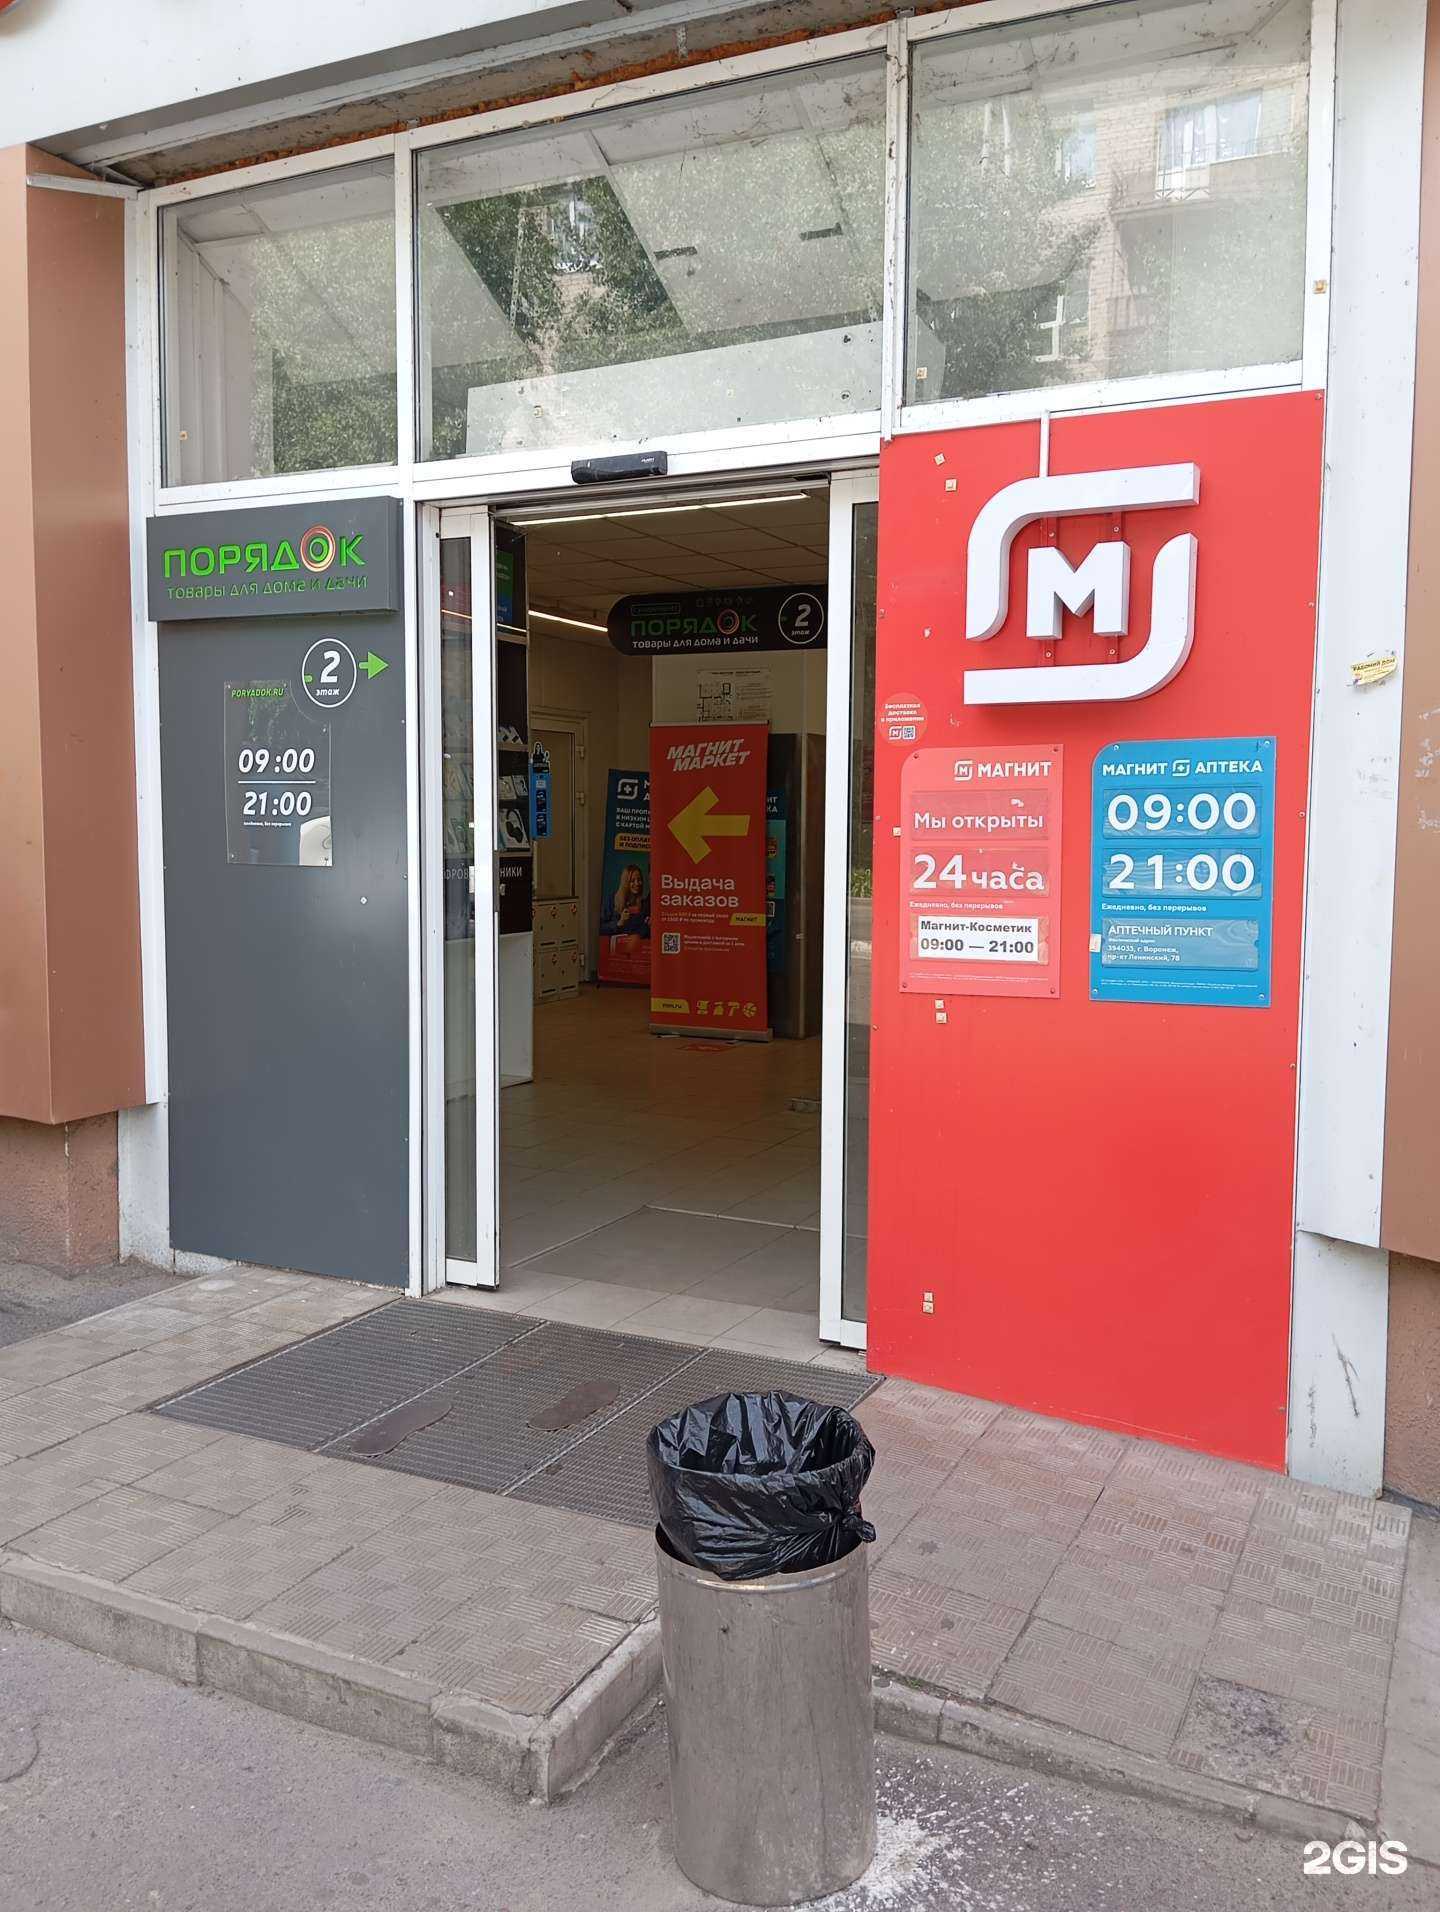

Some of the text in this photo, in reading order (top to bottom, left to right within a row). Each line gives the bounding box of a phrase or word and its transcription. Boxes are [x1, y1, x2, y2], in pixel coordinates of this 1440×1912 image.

[164, 526, 366, 578] ПОРЯДОК
[168, 575, 368, 600] товары для дома и дачи
[631, 609, 757, 637] ПОРЯДОК
[795, 604, 812, 627] 2
[633, 635, 759, 650] товары для дома и дачи
[320, 650, 341, 683] 2
[231, 688, 284, 698] PORYADOK.RU
[316, 688, 340, 696] этаж
[667, 739, 744, 760] МАГНИТ
[238, 748, 315, 773] 09:00
[673, 751, 750, 772] МАРКЕТ
[977, 761, 1052, 778] МАГНИТ
[1102, 760, 1263, 776] МАГНИТ АПТЕКА
[243, 791, 312, 816] 21:00
[1108, 792, 1256, 831] 09:00
[914, 812, 1043, 833] Мы открыты
[913, 853, 1045, 890] 24 часа
[1109, 853, 1254, 891] 21:00
[661, 873, 736, 892] Выдача
[660, 894, 740, 908] заказов
[964, 903, 1003, 911] перерывов
[1101, 903, 1207, 913] Ежедневно, без перерывов
[920, 920, 1032, 933] Магнит-Косметик
[1108, 924, 1214, 937] АПТЕЧНЫЙ ПУНКТ
[920, 938, 964, 951] 09:00
[989, 940, 1034, 953] 21:00
